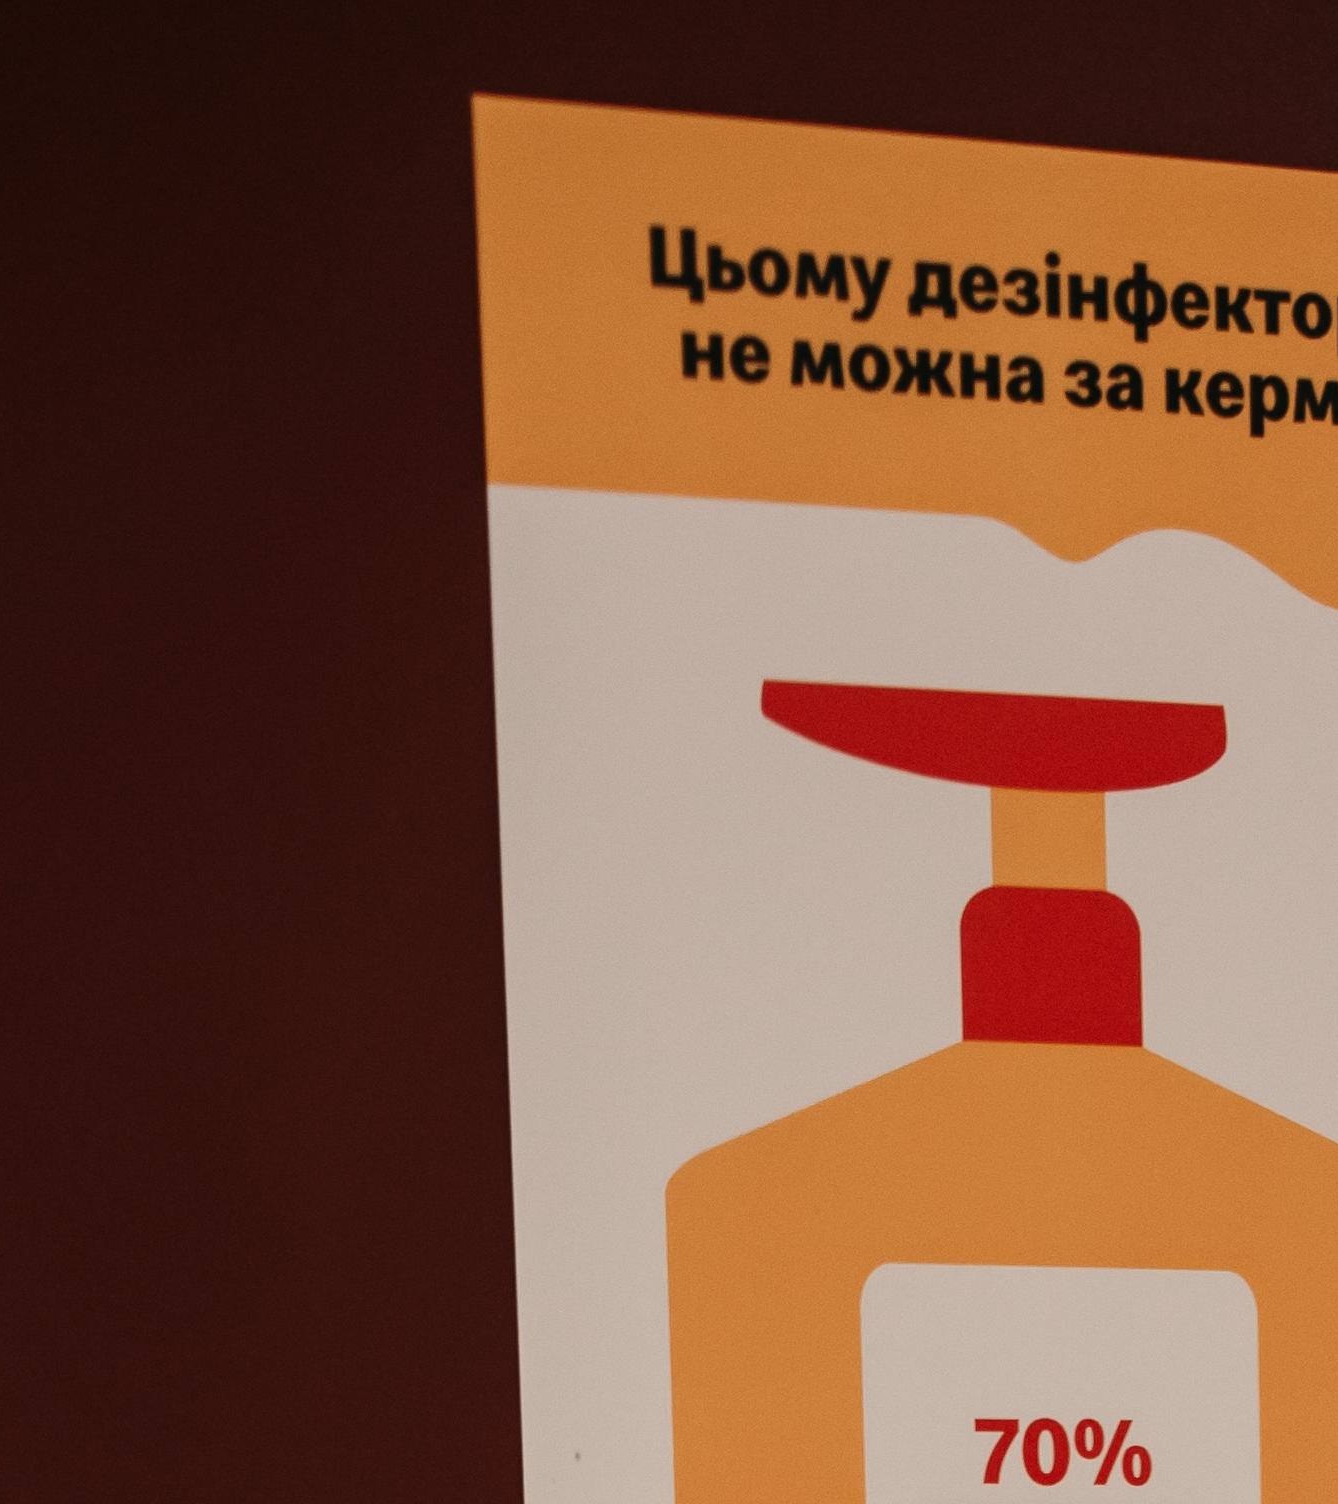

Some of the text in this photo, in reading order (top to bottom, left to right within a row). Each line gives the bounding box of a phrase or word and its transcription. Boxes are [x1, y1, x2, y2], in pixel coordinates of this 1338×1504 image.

[648, 224, 892, 323] Цьому
[681, 331, 771, 384] не
[790, 337, 1046, 404] можна
[1064, 357, 1147, 411] за
[974, 1418, 1152, 1486] 70%
